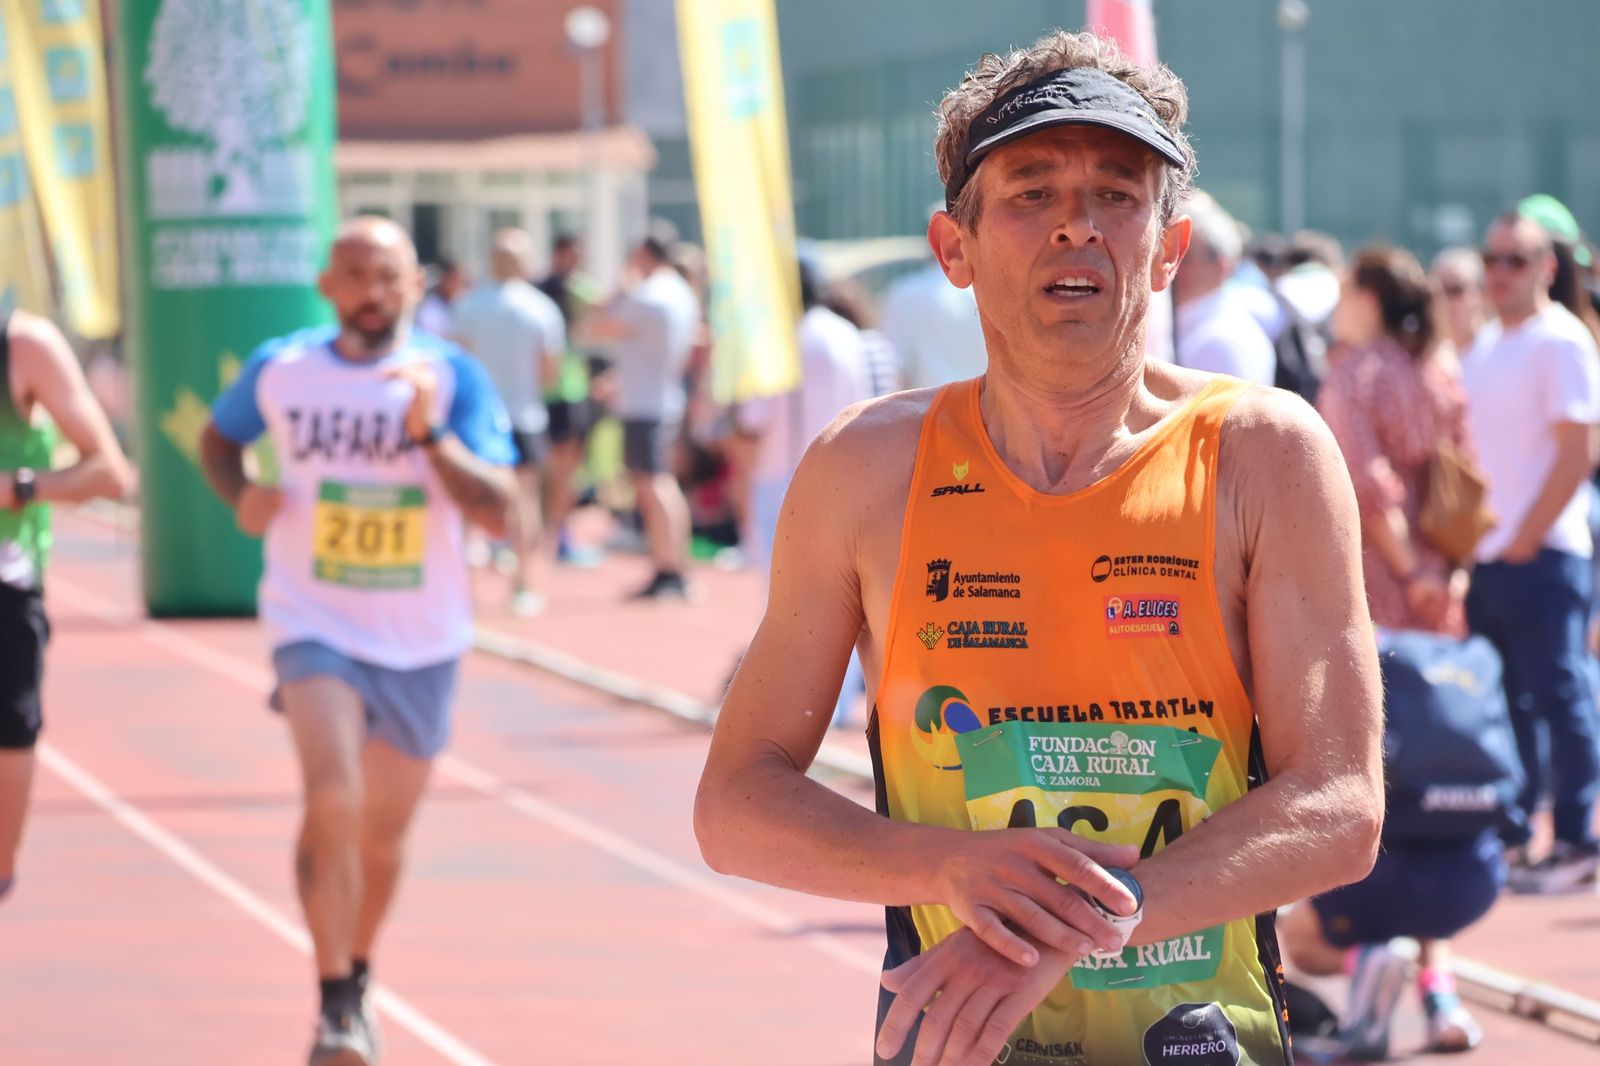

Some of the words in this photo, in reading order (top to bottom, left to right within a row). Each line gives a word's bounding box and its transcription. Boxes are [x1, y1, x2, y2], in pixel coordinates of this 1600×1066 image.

[931, 483, 985, 497] SPALL
[325, 509, 408, 557] 201
[1114, 555, 1144, 565] ESTER
[953, 571, 1021, 585] Ayuntamiento
[1113, 565, 1157, 577] CLÍNICA
[1160, 567, 1198, 580] DENTAL
[953, 586, 965, 598] de
[967, 586, 1021, 599] Salamanca
[1138, 600, 1179, 618] ELICES
[947, 621, 980, 635] CAJA
[982, 621, 1028, 636] RURAL
[1109, 623, 1166, 634] AUTOESCUELA
[947, 637, 961, 649] DE
[962, 636, 1029, 649] SALAMANCA
[988, 703, 1104, 726] ESCUELA
[1031, 754, 1081, 774] CAJA
[1086, 756, 1156, 776] RURAL
[1034, 774, 1046, 785] DE
[1049, 776, 1101, 786] ZAMORA
[1136, 936, 1211, 967] RURAL
[1162, 1040, 1227, 1057] HERRERO
